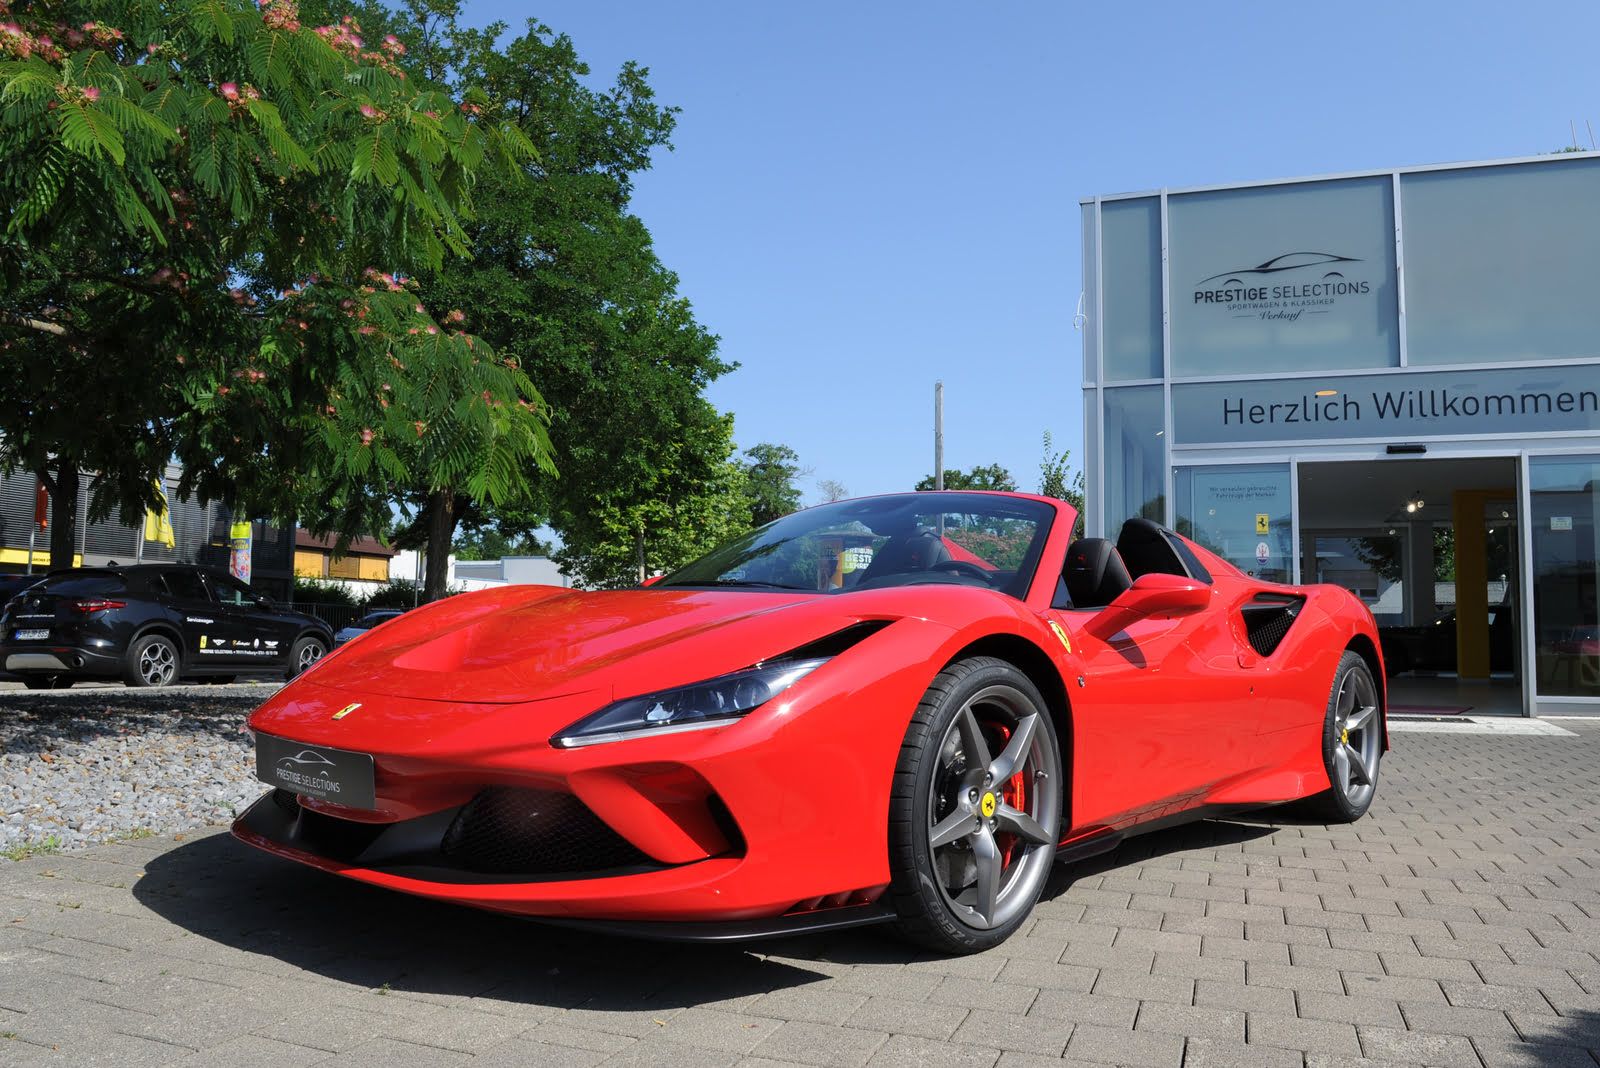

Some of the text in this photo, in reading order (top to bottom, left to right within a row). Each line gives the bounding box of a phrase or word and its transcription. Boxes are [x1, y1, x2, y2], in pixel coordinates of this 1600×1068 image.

[1194, 281, 1370, 304] PRESTIGE SELECTIONS
[1227, 301, 1280, 311] SPORTWAGEN
[1291, 298, 1335, 308] KLASSIKER
[1259, 309, 1303, 322] Verkauf
[1223, 388, 1599, 425] Herzlich Willkommen
[276, 767, 341, 793] PRESTIGE SELECTIONS
[928, 901, 966, 941] ZERO
